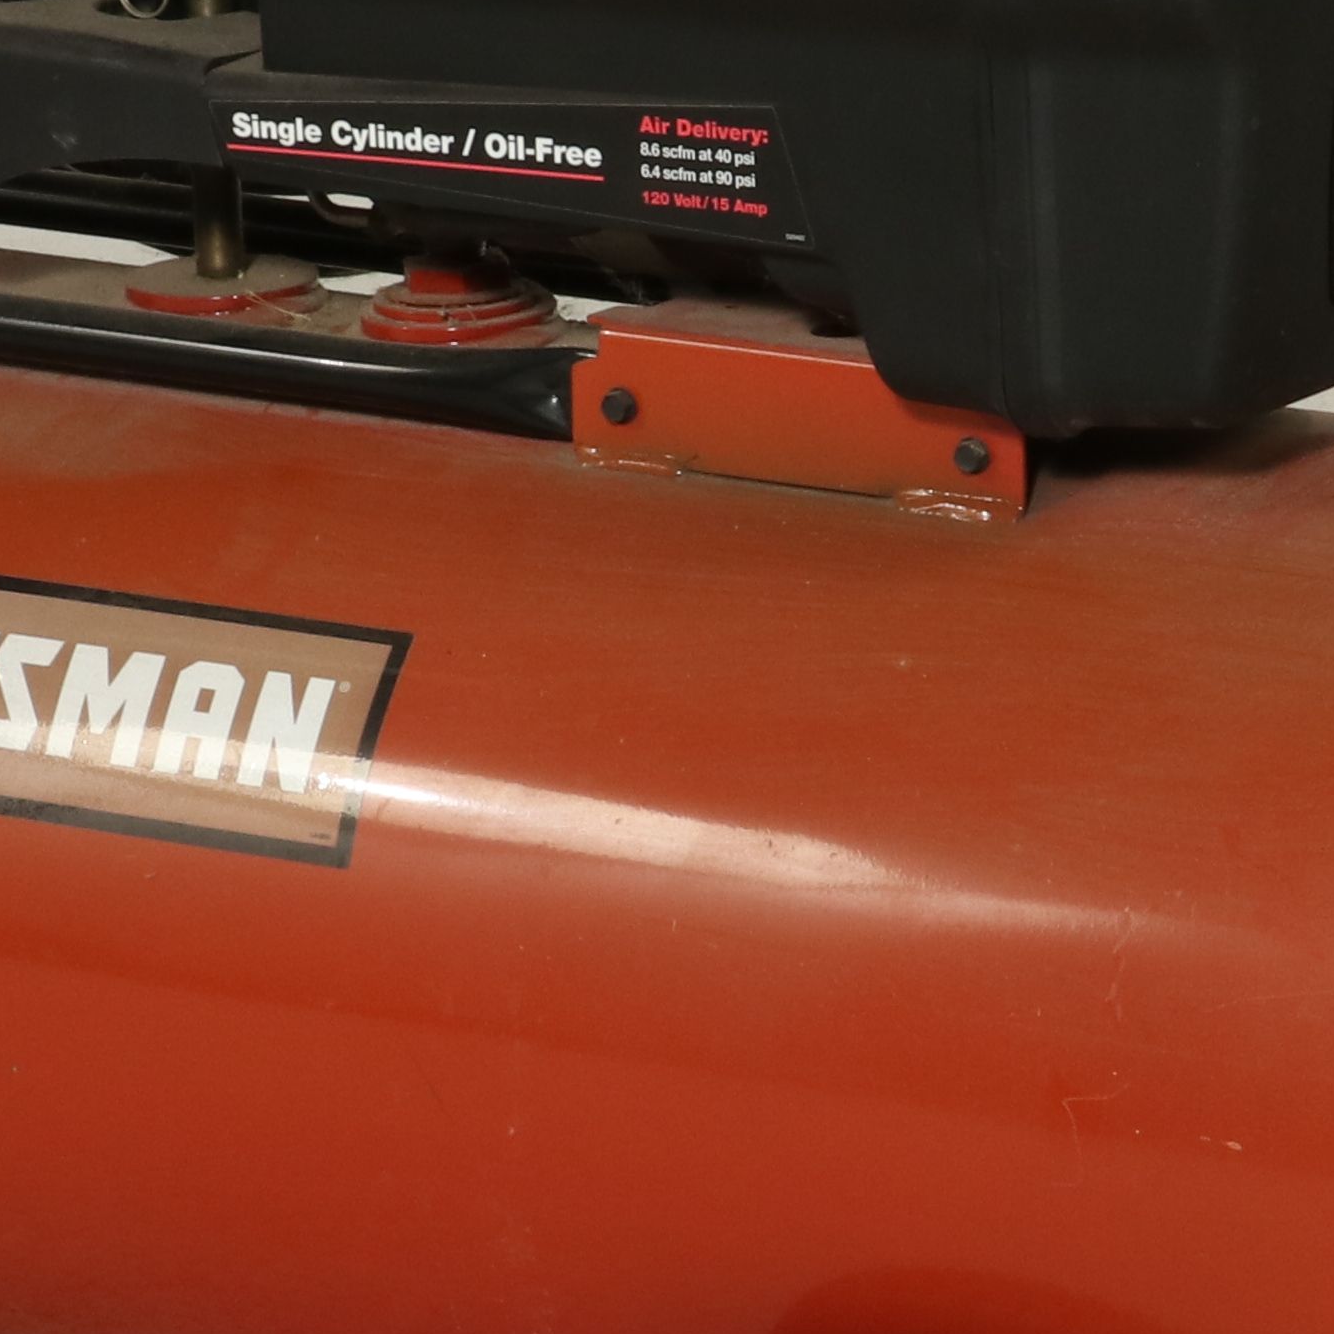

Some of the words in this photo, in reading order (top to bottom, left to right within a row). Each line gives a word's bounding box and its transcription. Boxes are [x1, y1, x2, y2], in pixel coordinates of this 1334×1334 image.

[232, 112, 322, 147] Single
[331, 120, 454, 155] Cylinder
[462, 128, 476, 157] /
[484, 132, 602, 167] Oil-Free
[639, 116, 670, 134] Air
[676, 118, 769, 146] Delivery:
[640, 142, 660, 157] 8.6
[662, 145, 696, 161] scfm
[698, 149, 713, 162] at
[715, 149, 732, 163] 40
[734, 151, 755, 167] psi
[640, 164, 660, 178] 6.4
[663, 167, 696, 182] scfm
[699, 170, 713, 184] at
[715, 170, 732, 185] 90
[735, 173, 756, 189] psi
[643, 191, 669, 205] 120
[734, 199, 768, 217] Amp
